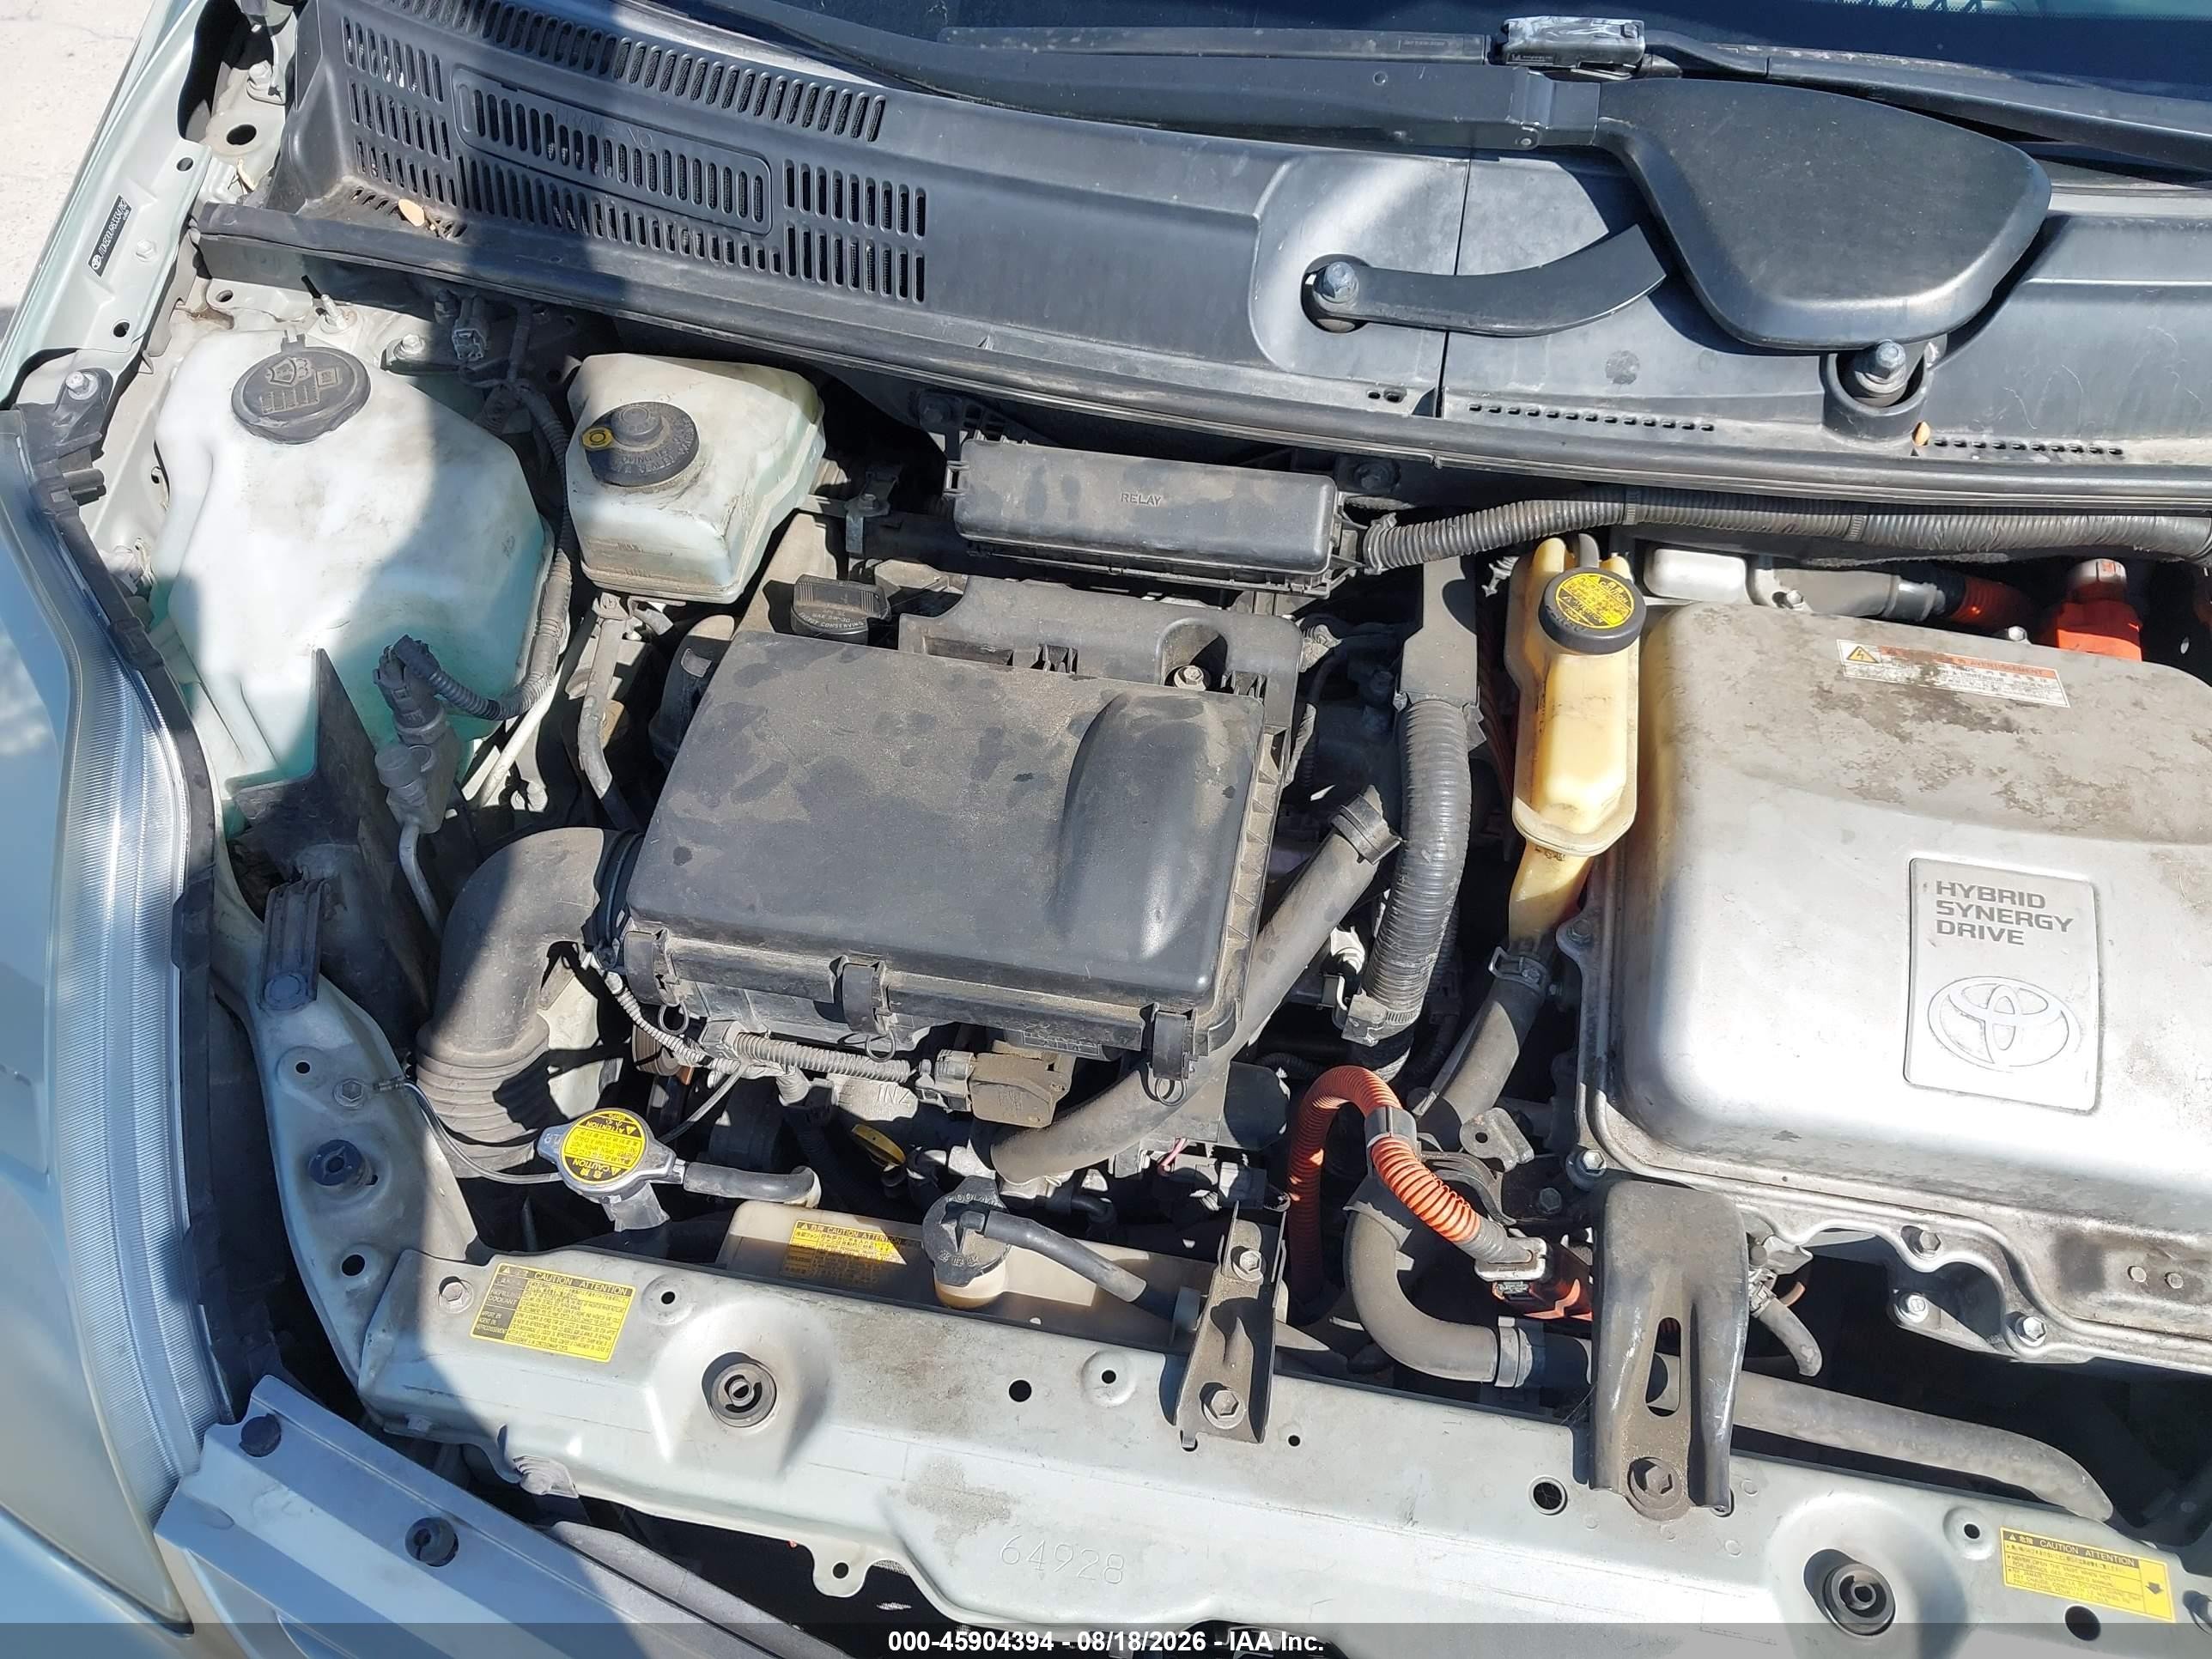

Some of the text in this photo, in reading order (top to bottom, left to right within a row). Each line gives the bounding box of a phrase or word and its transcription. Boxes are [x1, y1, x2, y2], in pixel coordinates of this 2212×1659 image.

[1121, 492, 1161, 507] RELAY
[1601, 581, 1628, 603] CAUTION
[1936, 881, 2045, 909] HYBRID
[1936, 900, 2074, 933] SYNERGY
[1936, 920, 2025, 945] DRIVE
[586, 1121, 624, 1133] ATTENTION
[572, 1158, 610, 1171] CAUTION
[828, 1227, 859, 1237] CAUTION
[534, 1272, 573, 1285] CAUTION
[579, 1280, 628, 1296] ATTENTION
[488, 1296, 518, 1305] COOLANT
[1000, 1534, 1125, 1584] 64928
[2039, 1540, 2079, 1554] CAUTION
[2085, 1549, 2135, 1566] ATTENTION
